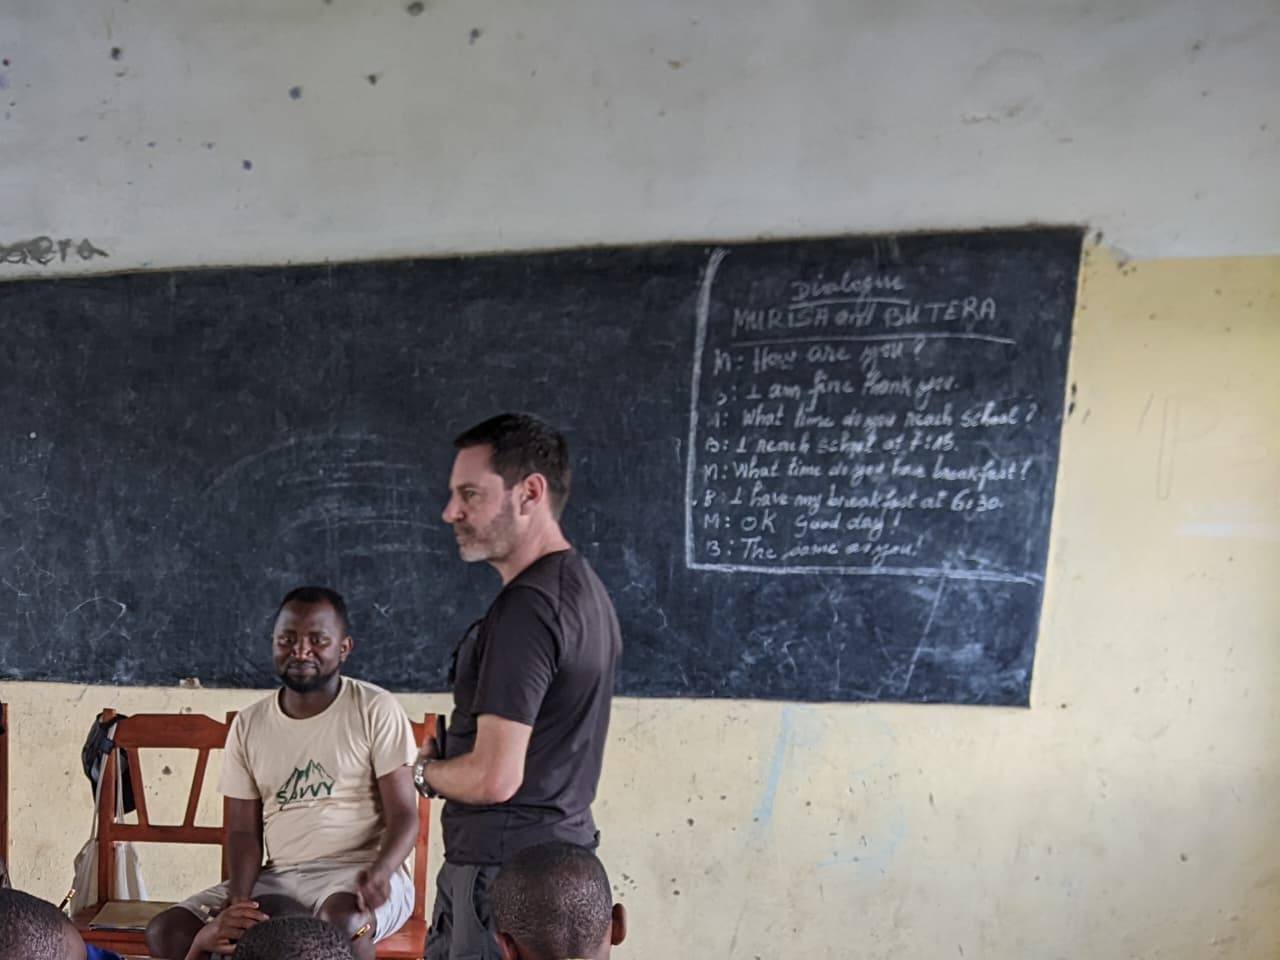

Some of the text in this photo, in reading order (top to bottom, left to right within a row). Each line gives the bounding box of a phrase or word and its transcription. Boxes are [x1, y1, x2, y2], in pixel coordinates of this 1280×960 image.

[808, 346, 851, 362] are
[769, 383, 801, 399] am
[732, 455, 779, 479] What
[788, 456, 821, 477] time
[750, 480, 789, 507] have
[794, 494, 822, 516] my
[739, 534, 778, 560] The
